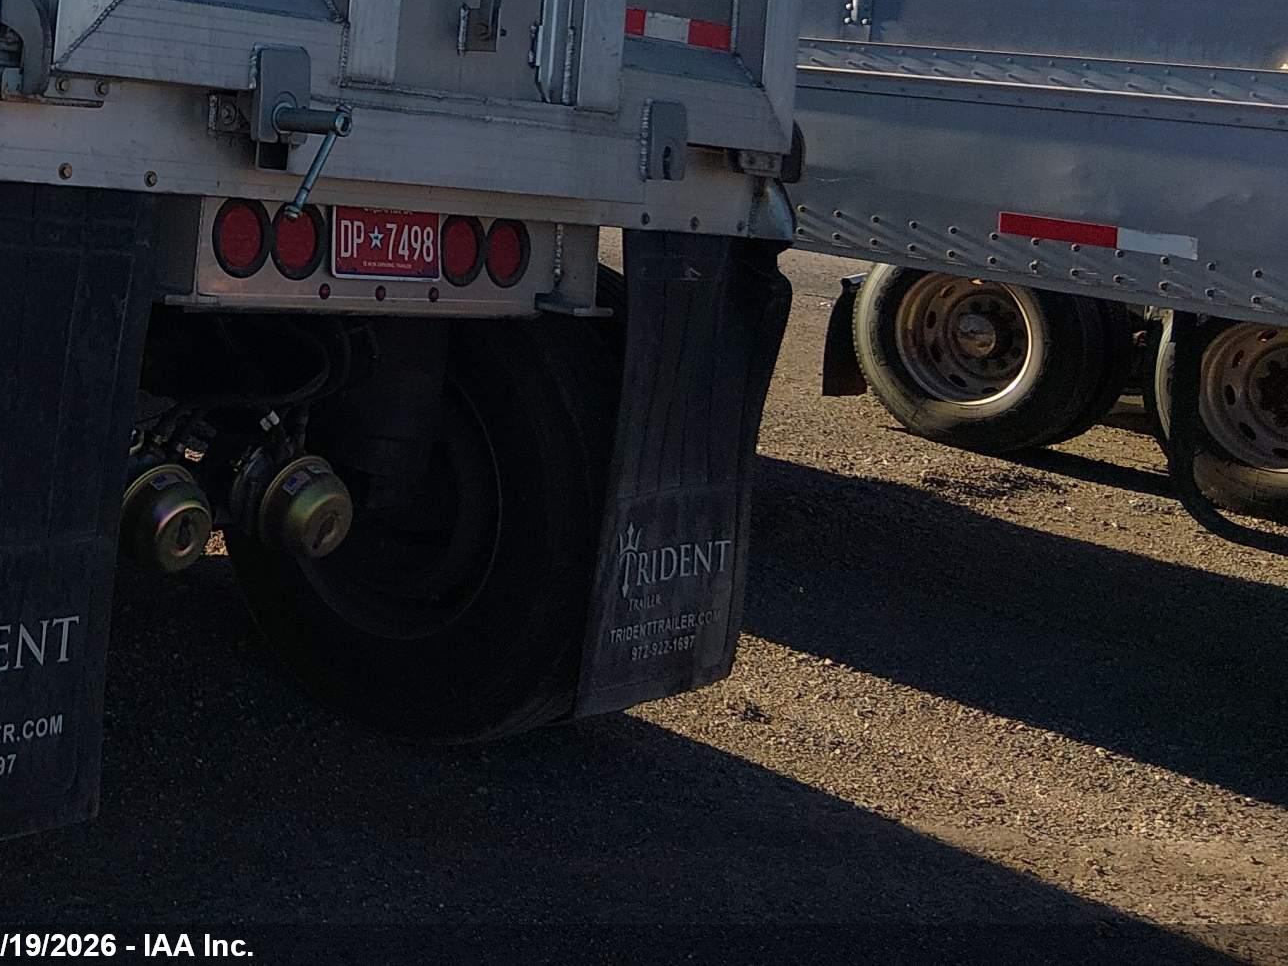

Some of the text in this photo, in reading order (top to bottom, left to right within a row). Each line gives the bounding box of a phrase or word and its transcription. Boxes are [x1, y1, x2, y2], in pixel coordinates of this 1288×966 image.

[340, 219, 434, 263] DP 7498
[617, 521, 732, 599] TRIDENT
[631, 634, 696, 661] 972-922-1697
